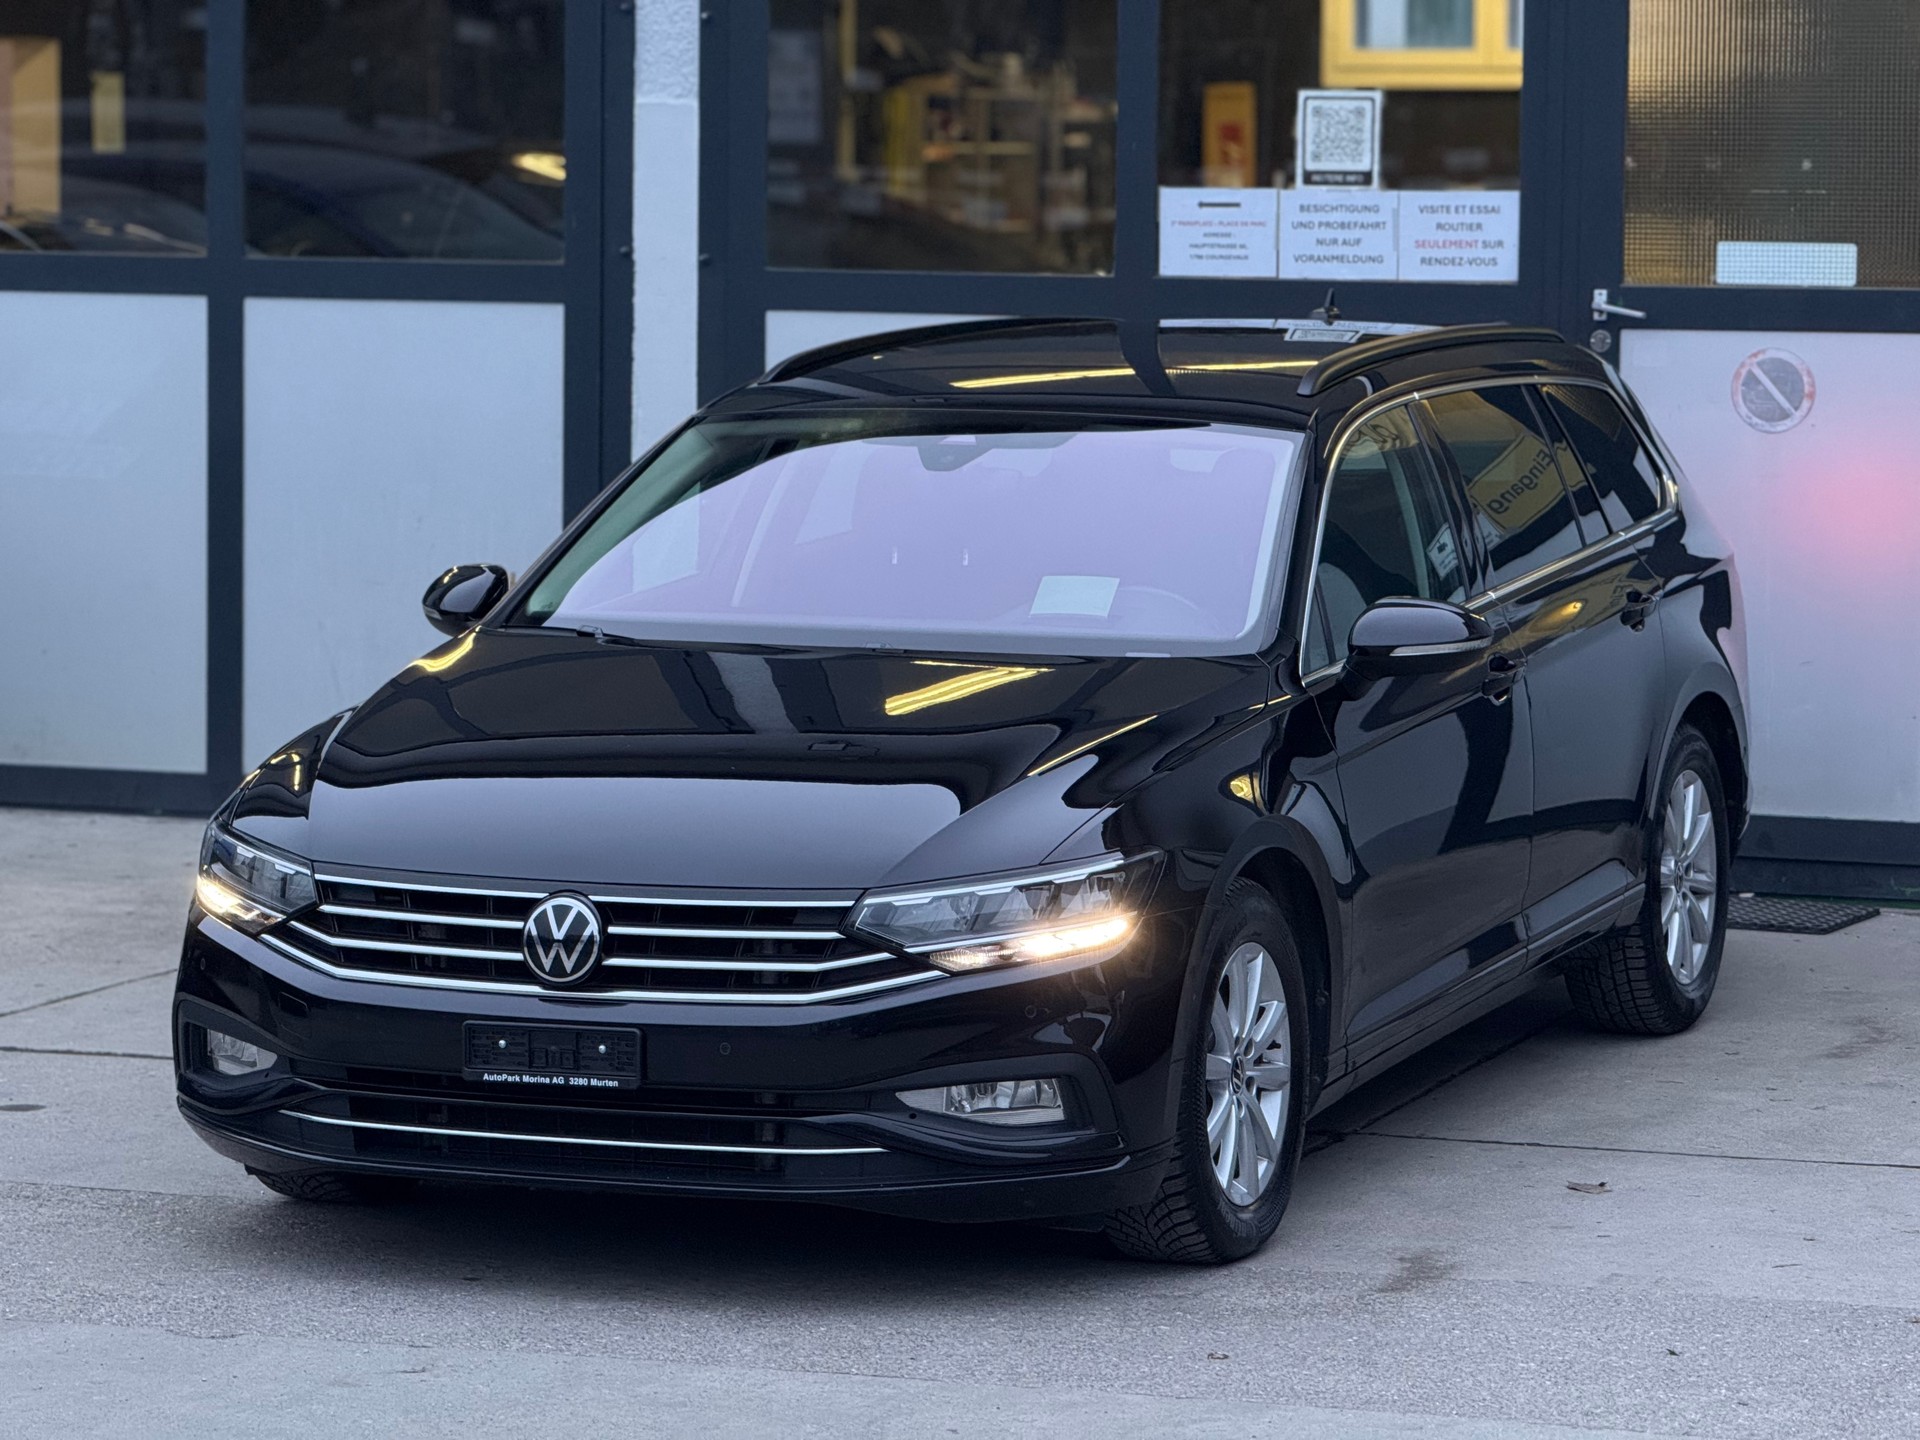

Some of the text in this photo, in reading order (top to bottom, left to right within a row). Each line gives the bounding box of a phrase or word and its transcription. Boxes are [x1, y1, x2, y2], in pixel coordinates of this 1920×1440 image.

[1299, 204, 1380, 214] BESICHTIGUNG
[1418, 205, 1501, 215] VISITE ET ESSAI
[1291, 221, 1387, 230] UND PROBEFAHRT
[1435, 222, 1483, 232] ROUTIER
[1315, 238, 1362, 247] NUR AUF
[1414, 240, 1504, 249] SEULEMENT SUR
[1293, 254, 1385, 264] VORANMELDUNG
[1420, 257, 1498, 267] RENDEZ-VOUS
[483, 1073, 619, 1087] AutoPark Morina AG 3280 Murten
